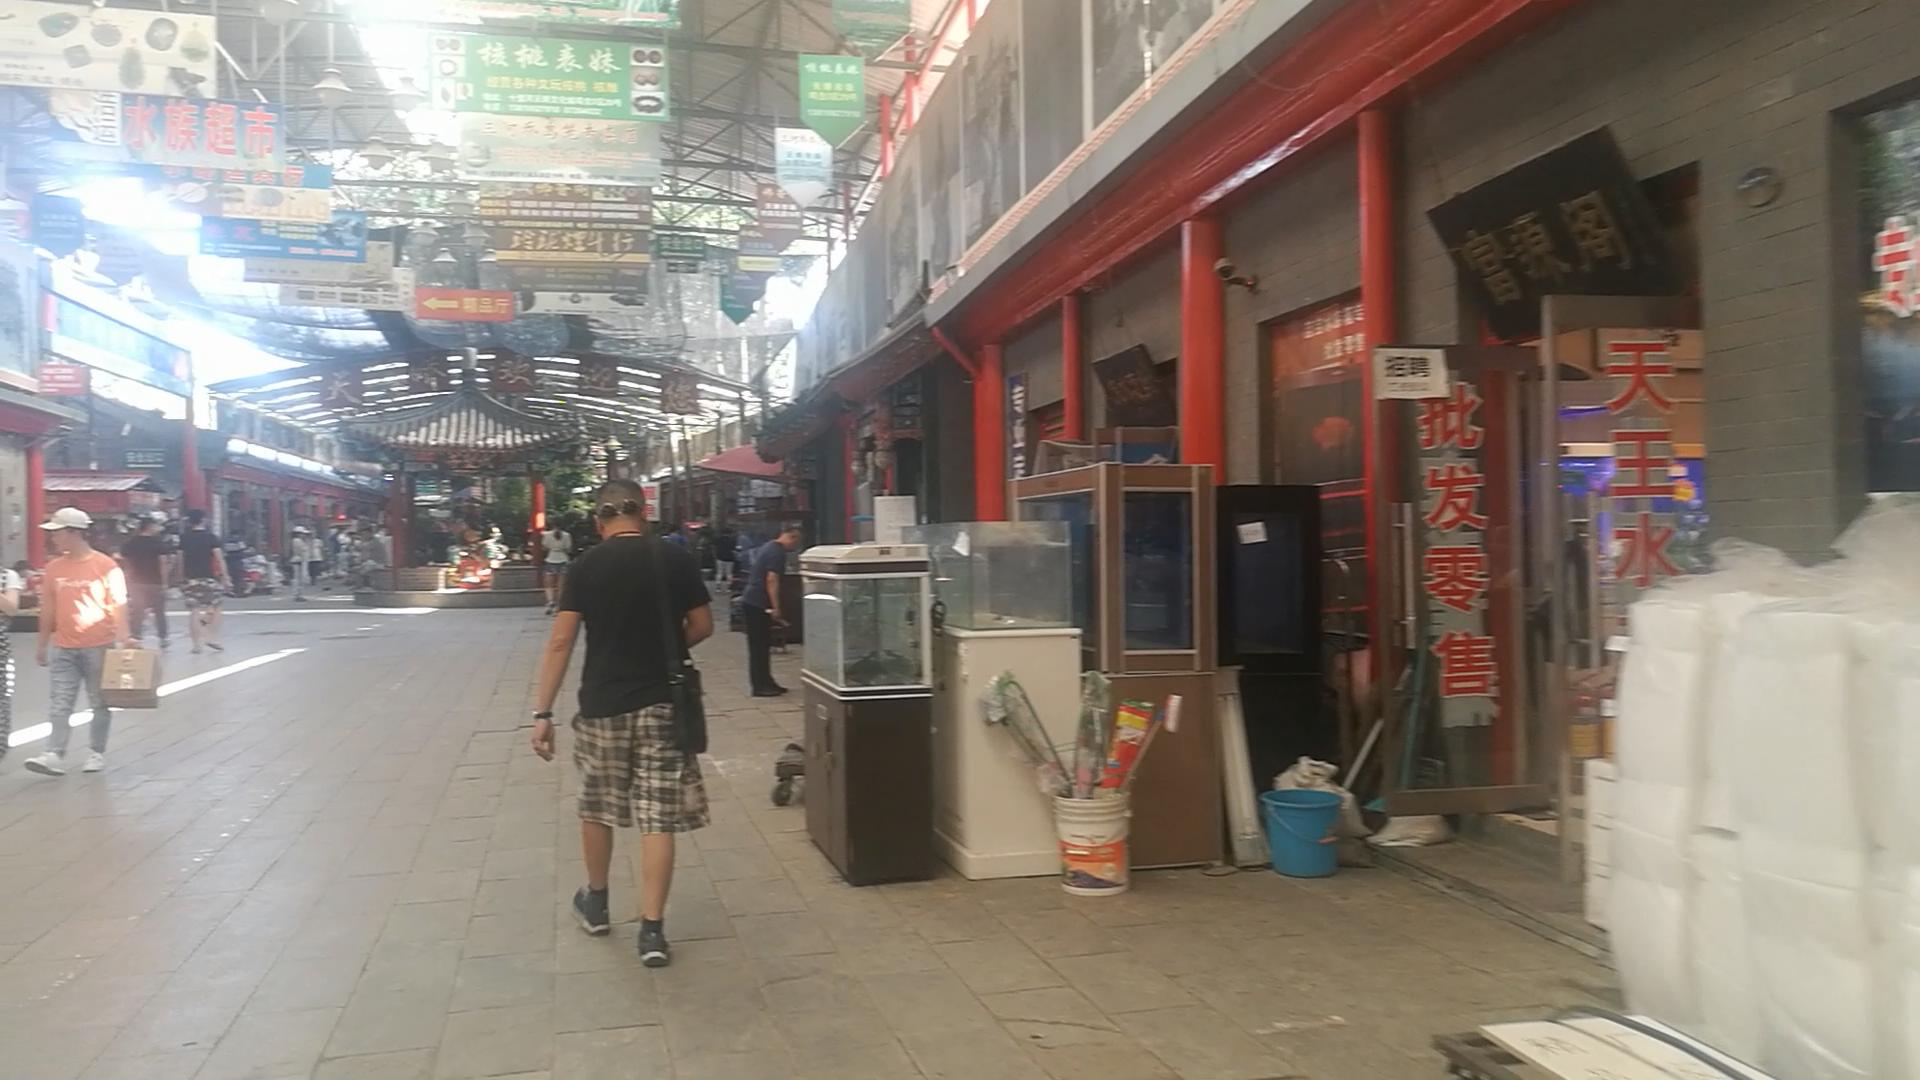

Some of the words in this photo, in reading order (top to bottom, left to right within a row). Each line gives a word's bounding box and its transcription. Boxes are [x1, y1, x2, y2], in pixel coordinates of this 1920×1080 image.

[477, 42, 621, 74] 核桃表妹
[123, 97, 278, 159] 水族超市
[463, 297, 510, 313] 精品厅
[1385, 355, 1432, 377] 招聘
[1607, 340, 1680, 588] 天王水
[1416, 381, 1500, 697] 批发零售
